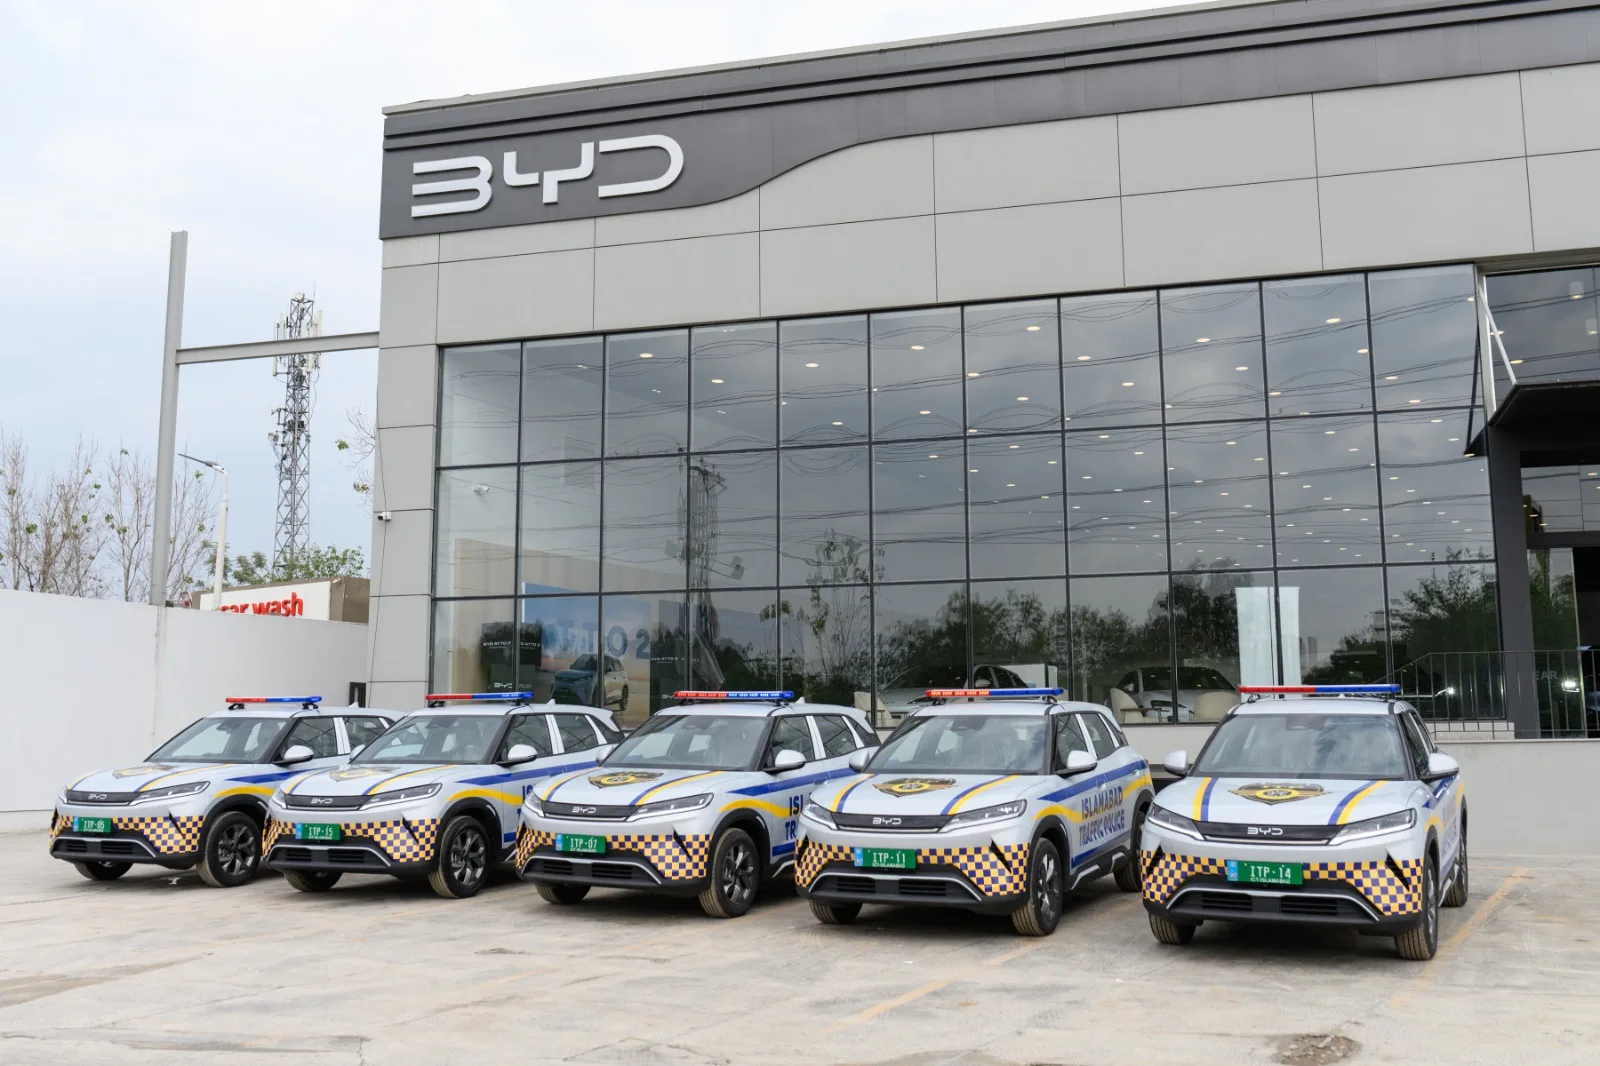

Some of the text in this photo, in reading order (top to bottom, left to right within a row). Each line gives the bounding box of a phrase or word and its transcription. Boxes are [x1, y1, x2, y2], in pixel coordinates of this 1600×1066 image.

[411, 134, 684, 217] BYD
[252, 592, 303, 616] wash
[635, 628, 650, 659] 2
[571, 806, 597, 814] BYD
[1081, 786, 1123, 820] ISLAMABAD
[872, 817, 902, 825] BYD
[1079, 809, 1125, 846] TRAFFIC POLICE
[1247, 826, 1284, 836] BYD
